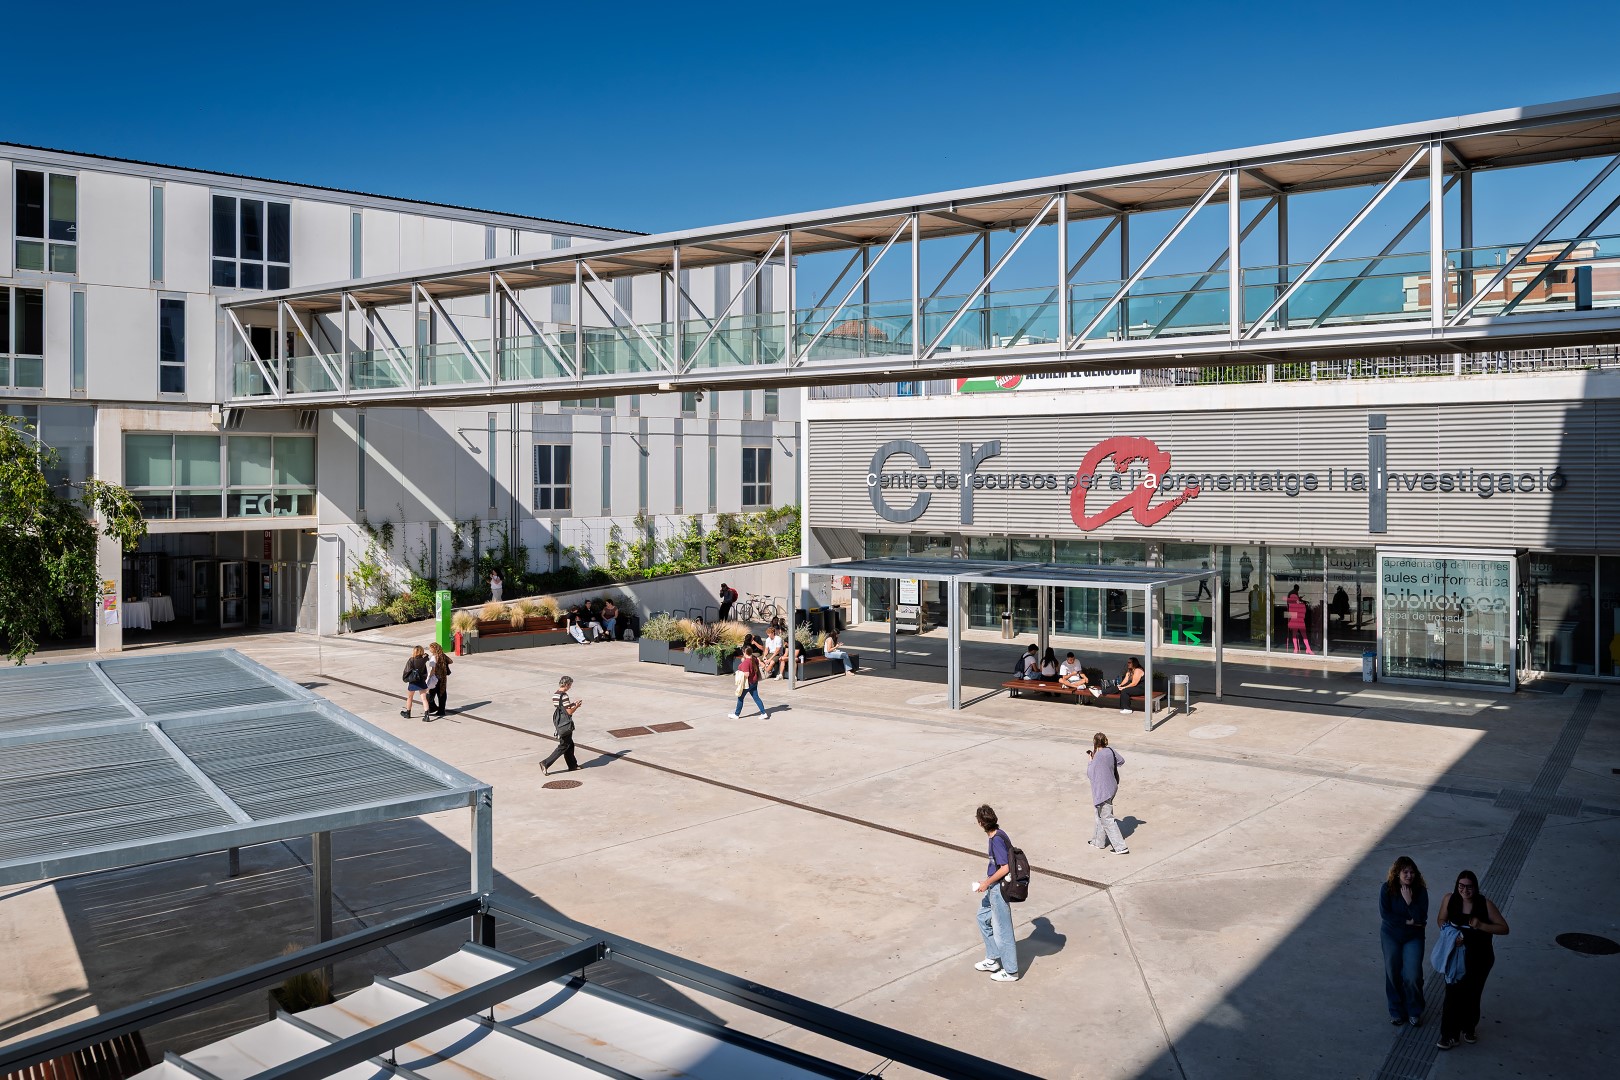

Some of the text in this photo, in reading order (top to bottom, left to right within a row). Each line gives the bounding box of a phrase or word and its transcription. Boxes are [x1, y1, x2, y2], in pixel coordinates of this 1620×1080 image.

[866, 469, 927, 489] centre
[933, 469, 959, 489] de
[964, 471, 1057, 490] recursos
[1064, 471, 1102, 495] per
[1343, 467, 1367, 492] la
[1384, 559, 1448, 570] aprenentatge
[1451, 560, 1464, 569] de
[1384, 572, 1418, 584] aules
[1384, 587, 1508, 614] biblioteca
[1412, 612, 1425, 621] de
